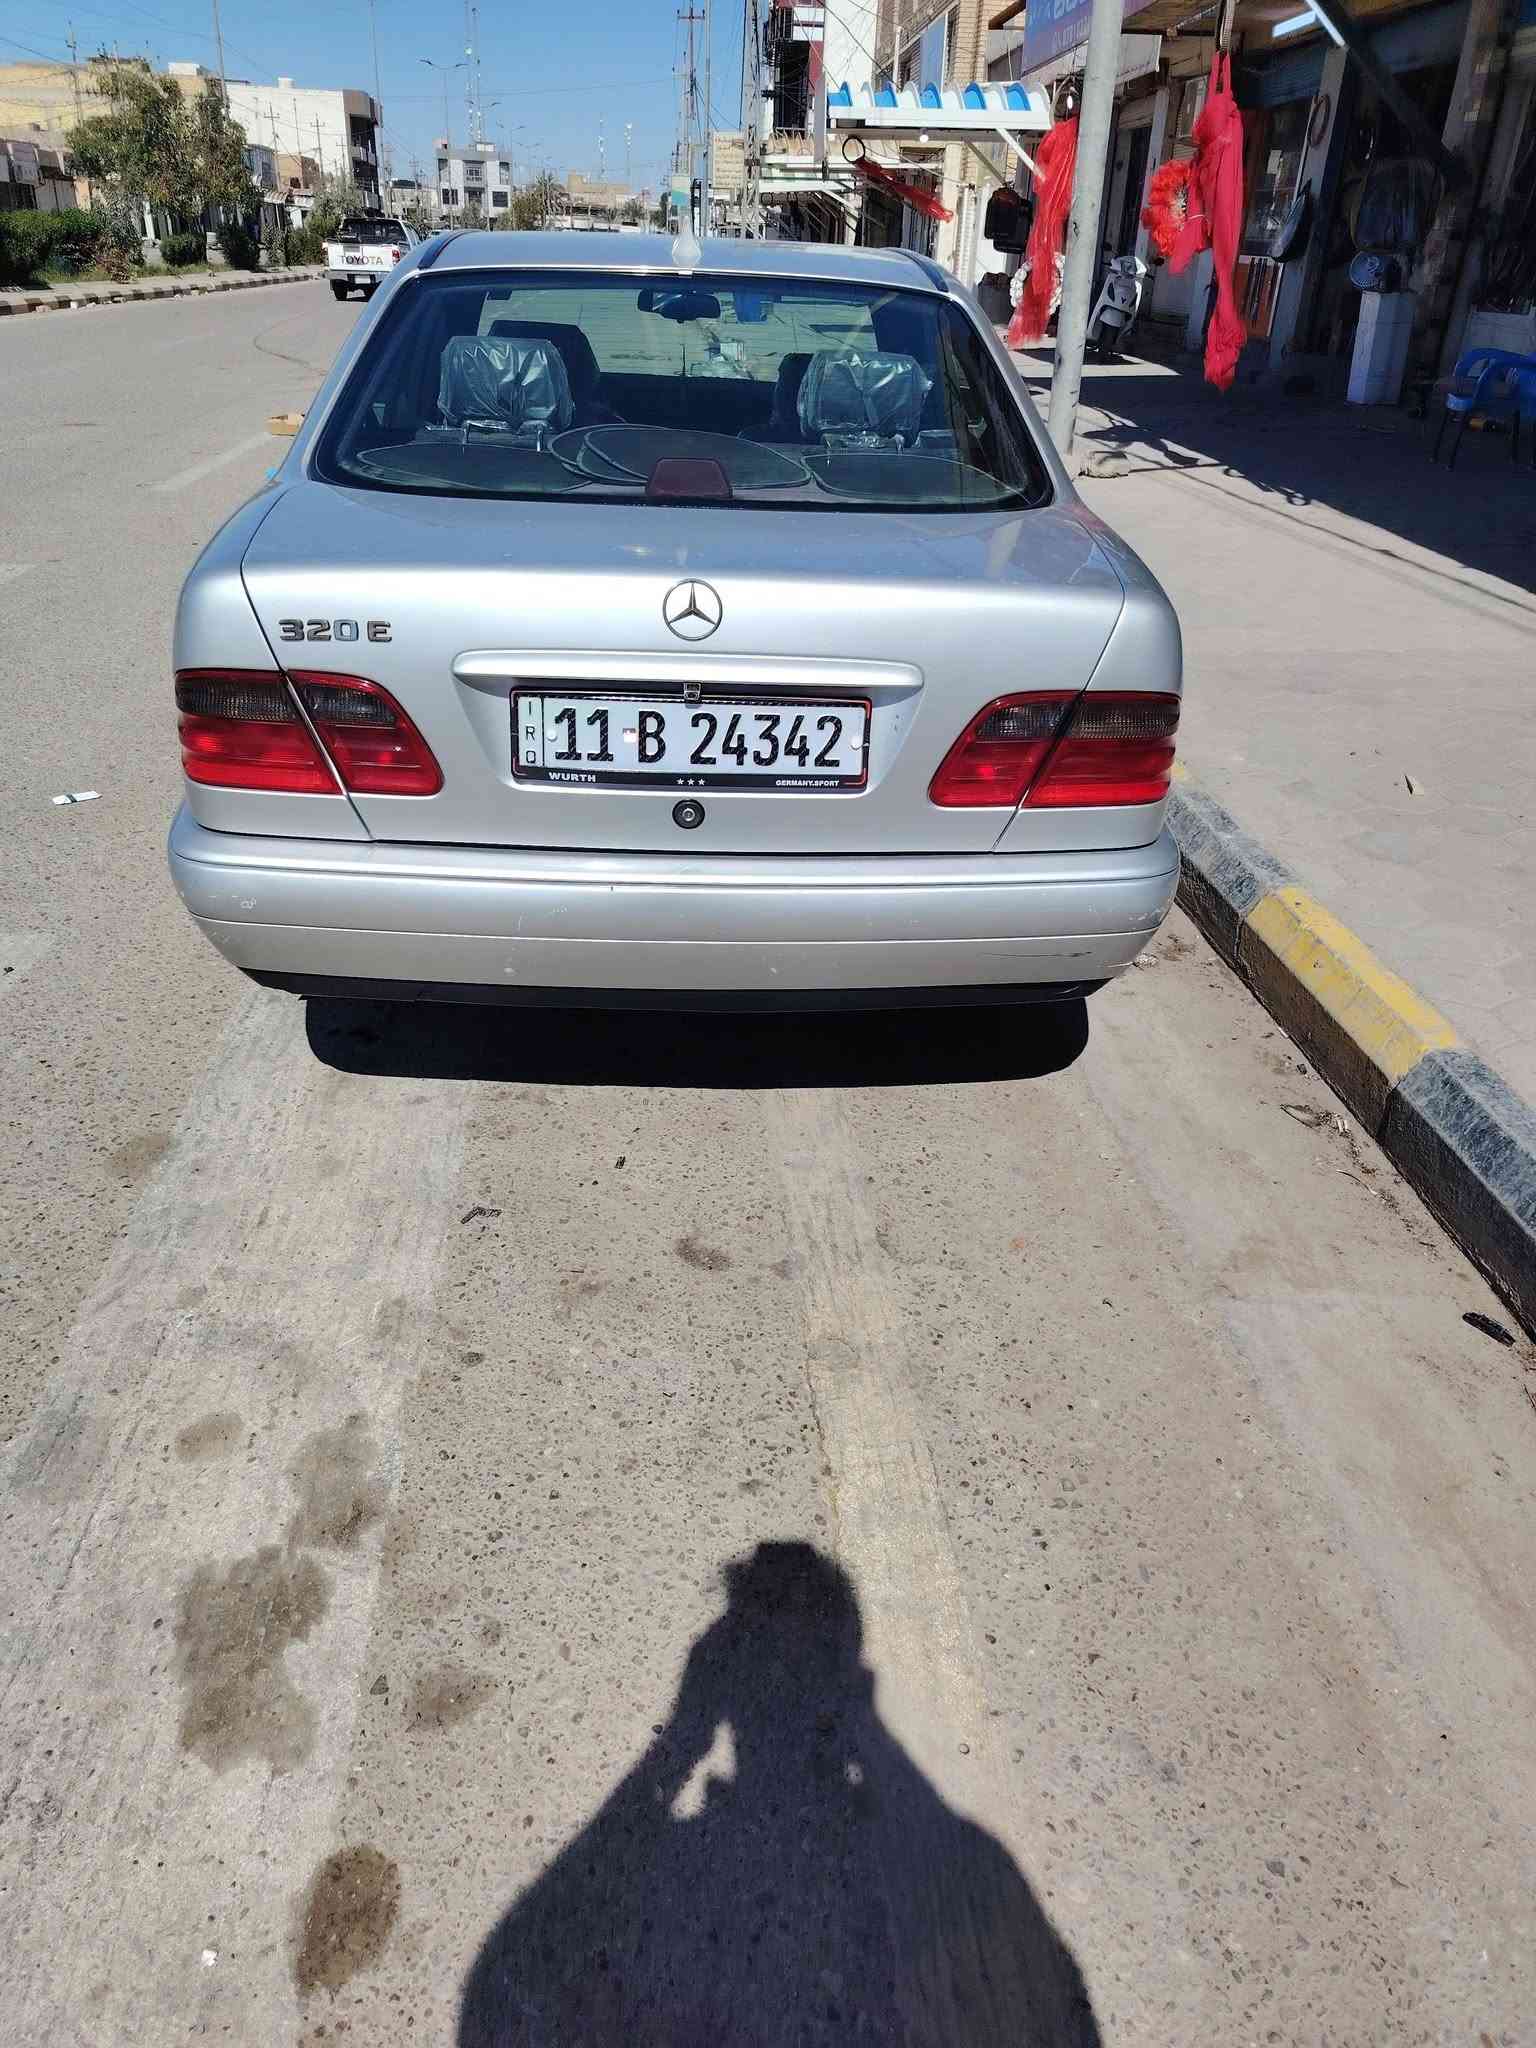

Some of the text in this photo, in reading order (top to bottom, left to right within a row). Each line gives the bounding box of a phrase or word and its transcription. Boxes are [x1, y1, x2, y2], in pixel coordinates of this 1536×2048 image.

[340, 256, 384, 265] TOYOTA
[279, 619, 392, 642] 320 E
[554, 707, 843, 768] 11 B 24342
[548, 771, 597, 783] WURTH
